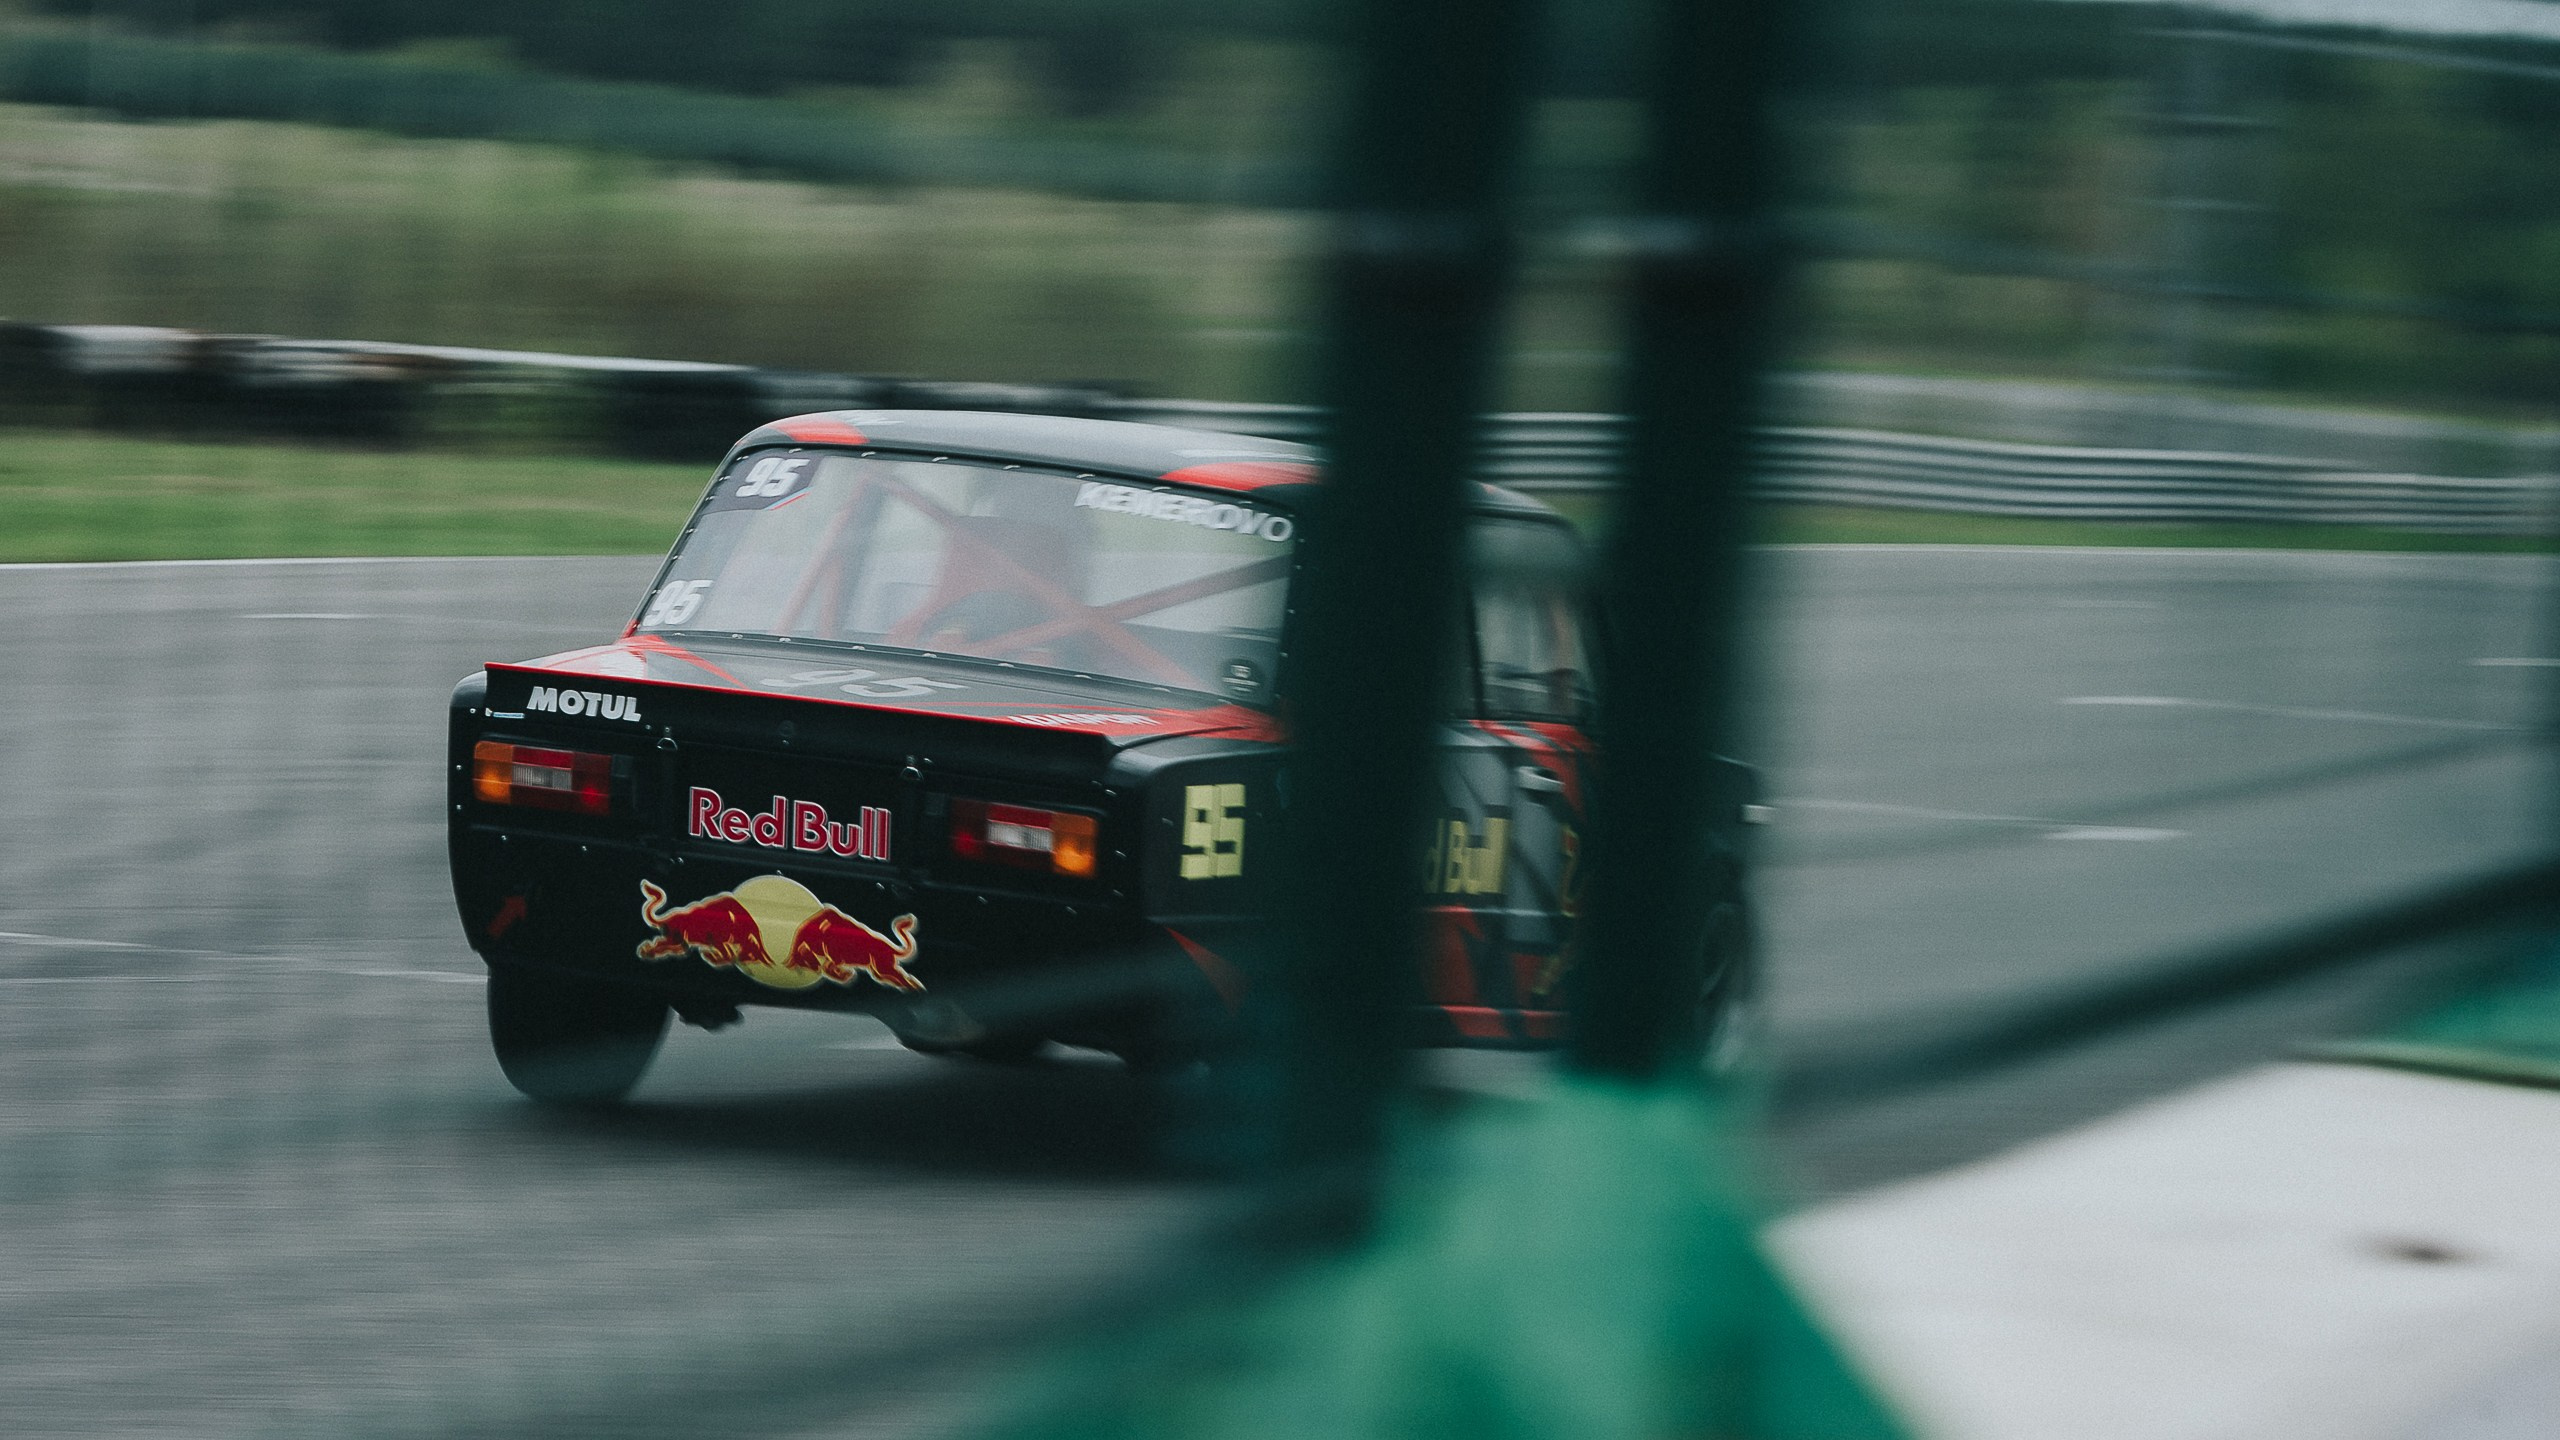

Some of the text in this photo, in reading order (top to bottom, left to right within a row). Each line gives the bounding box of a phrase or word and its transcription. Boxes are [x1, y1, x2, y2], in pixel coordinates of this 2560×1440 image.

[735, 457, 811, 497] 95
[1074, 482, 1293, 542] KEMEROVO
[642, 579, 714, 626] 95
[526, 686, 642, 722] MOTUL
[759, 668, 970, 698] 95
[689, 786, 891, 862] Red Bull
[1180, 783, 1246, 880] 95
